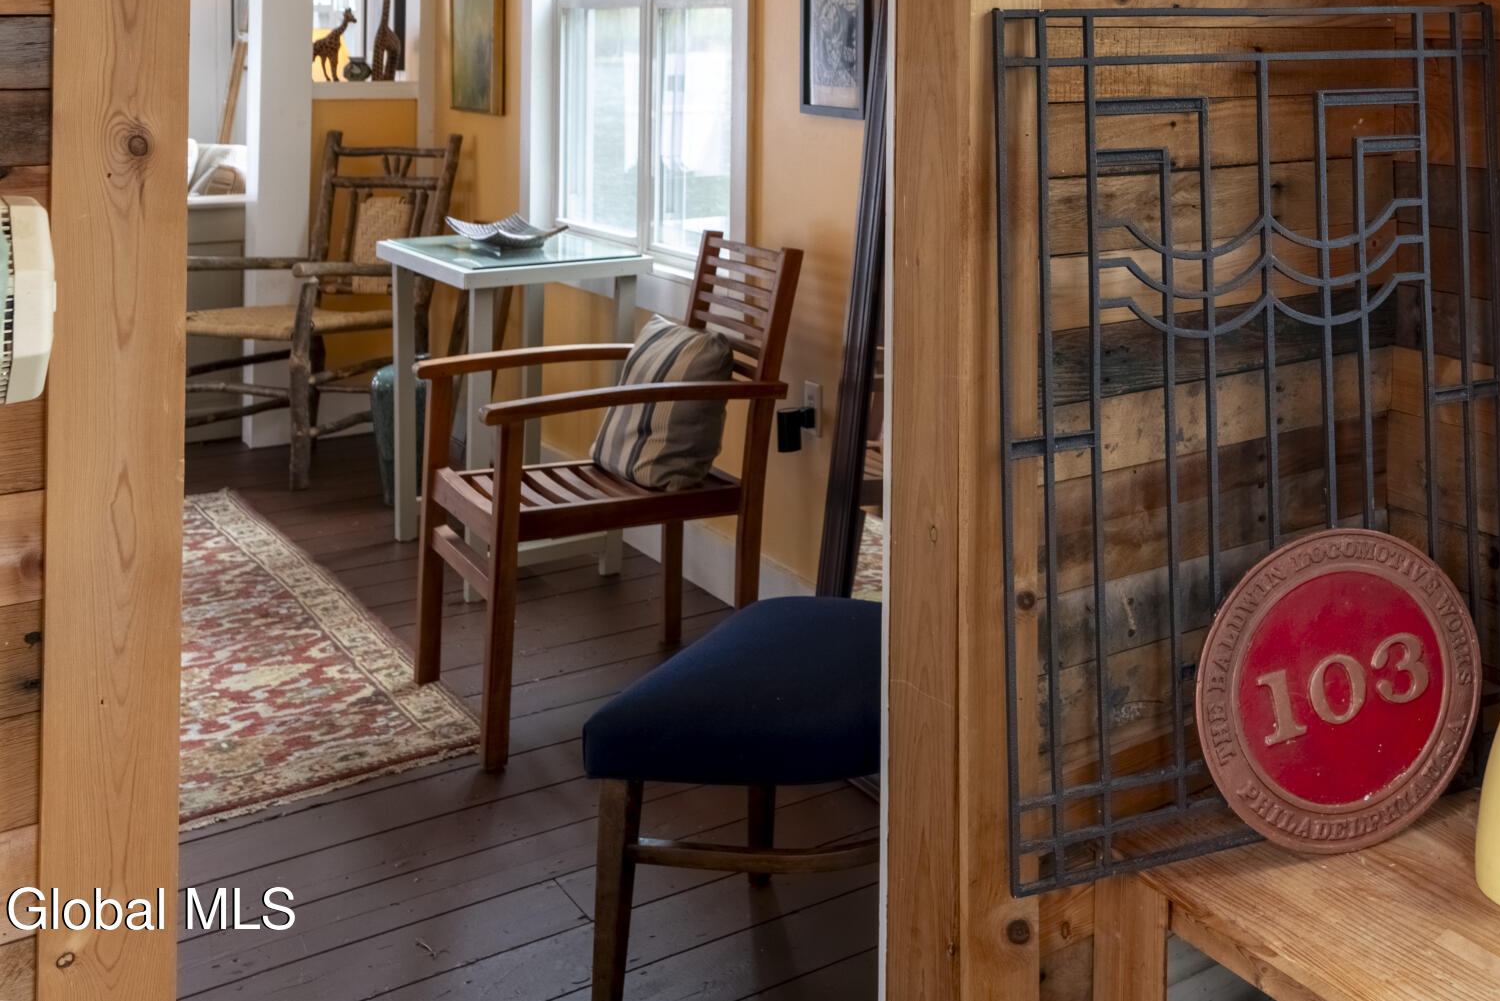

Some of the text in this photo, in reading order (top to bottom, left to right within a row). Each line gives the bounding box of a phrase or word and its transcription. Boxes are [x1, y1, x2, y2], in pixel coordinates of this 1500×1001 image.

[1206, 541, 1474, 766] THE BALDWIN LOCOMOTIVE WORKS
[1257, 632, 1430, 747] 103
